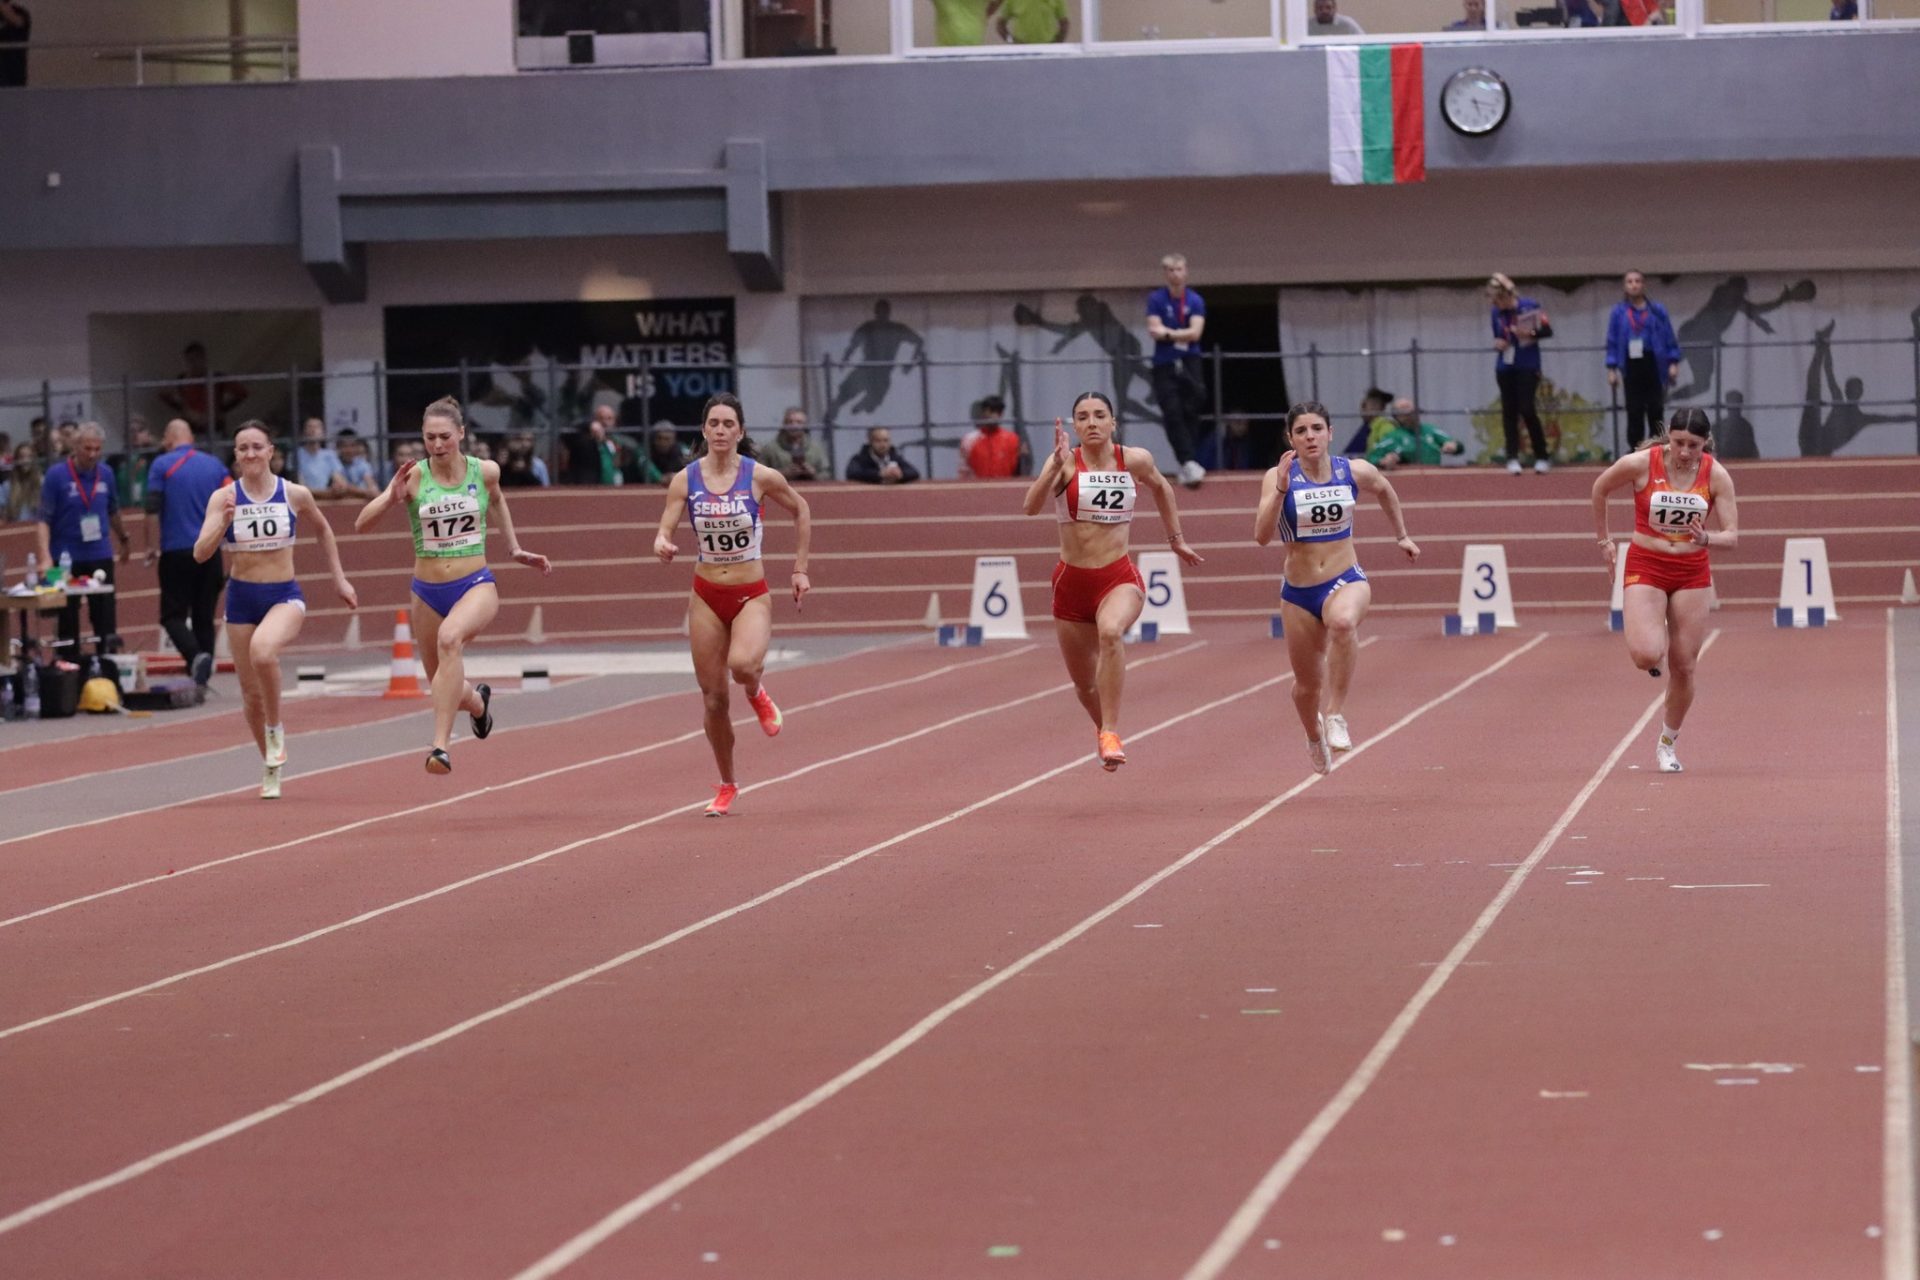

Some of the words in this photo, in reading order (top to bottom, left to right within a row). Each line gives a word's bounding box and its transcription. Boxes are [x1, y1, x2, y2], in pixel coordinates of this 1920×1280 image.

[635, 311, 725, 337] WHAT
[580, 342, 728, 368] MATTERS
[626, 373, 656, 399] IS
[664, 372, 728, 397] YOU
[1089, 475, 1126, 484] BLSTC
[1091, 489, 1125, 510] 42
[1305, 489, 1341, 500] BLSTC
[1661, 495, 1696, 506] BLSTC
[242, 506, 275, 515] BLSTC
[429, 501, 466, 514] BLSTC
[693, 500, 748, 515] SERBIA
[1311, 503, 1343, 524] 89
[247, 519, 278, 538] 10
[427, 515, 476, 538] 172
[704, 519, 740, 529] BLSTC
[703, 530, 750, 552] 196
[1474, 563, 1496, 600] 3
[1799, 559, 1812, 595] 1
[984, 580, 1008, 617] 6
[1148, 571, 1171, 607] 5
